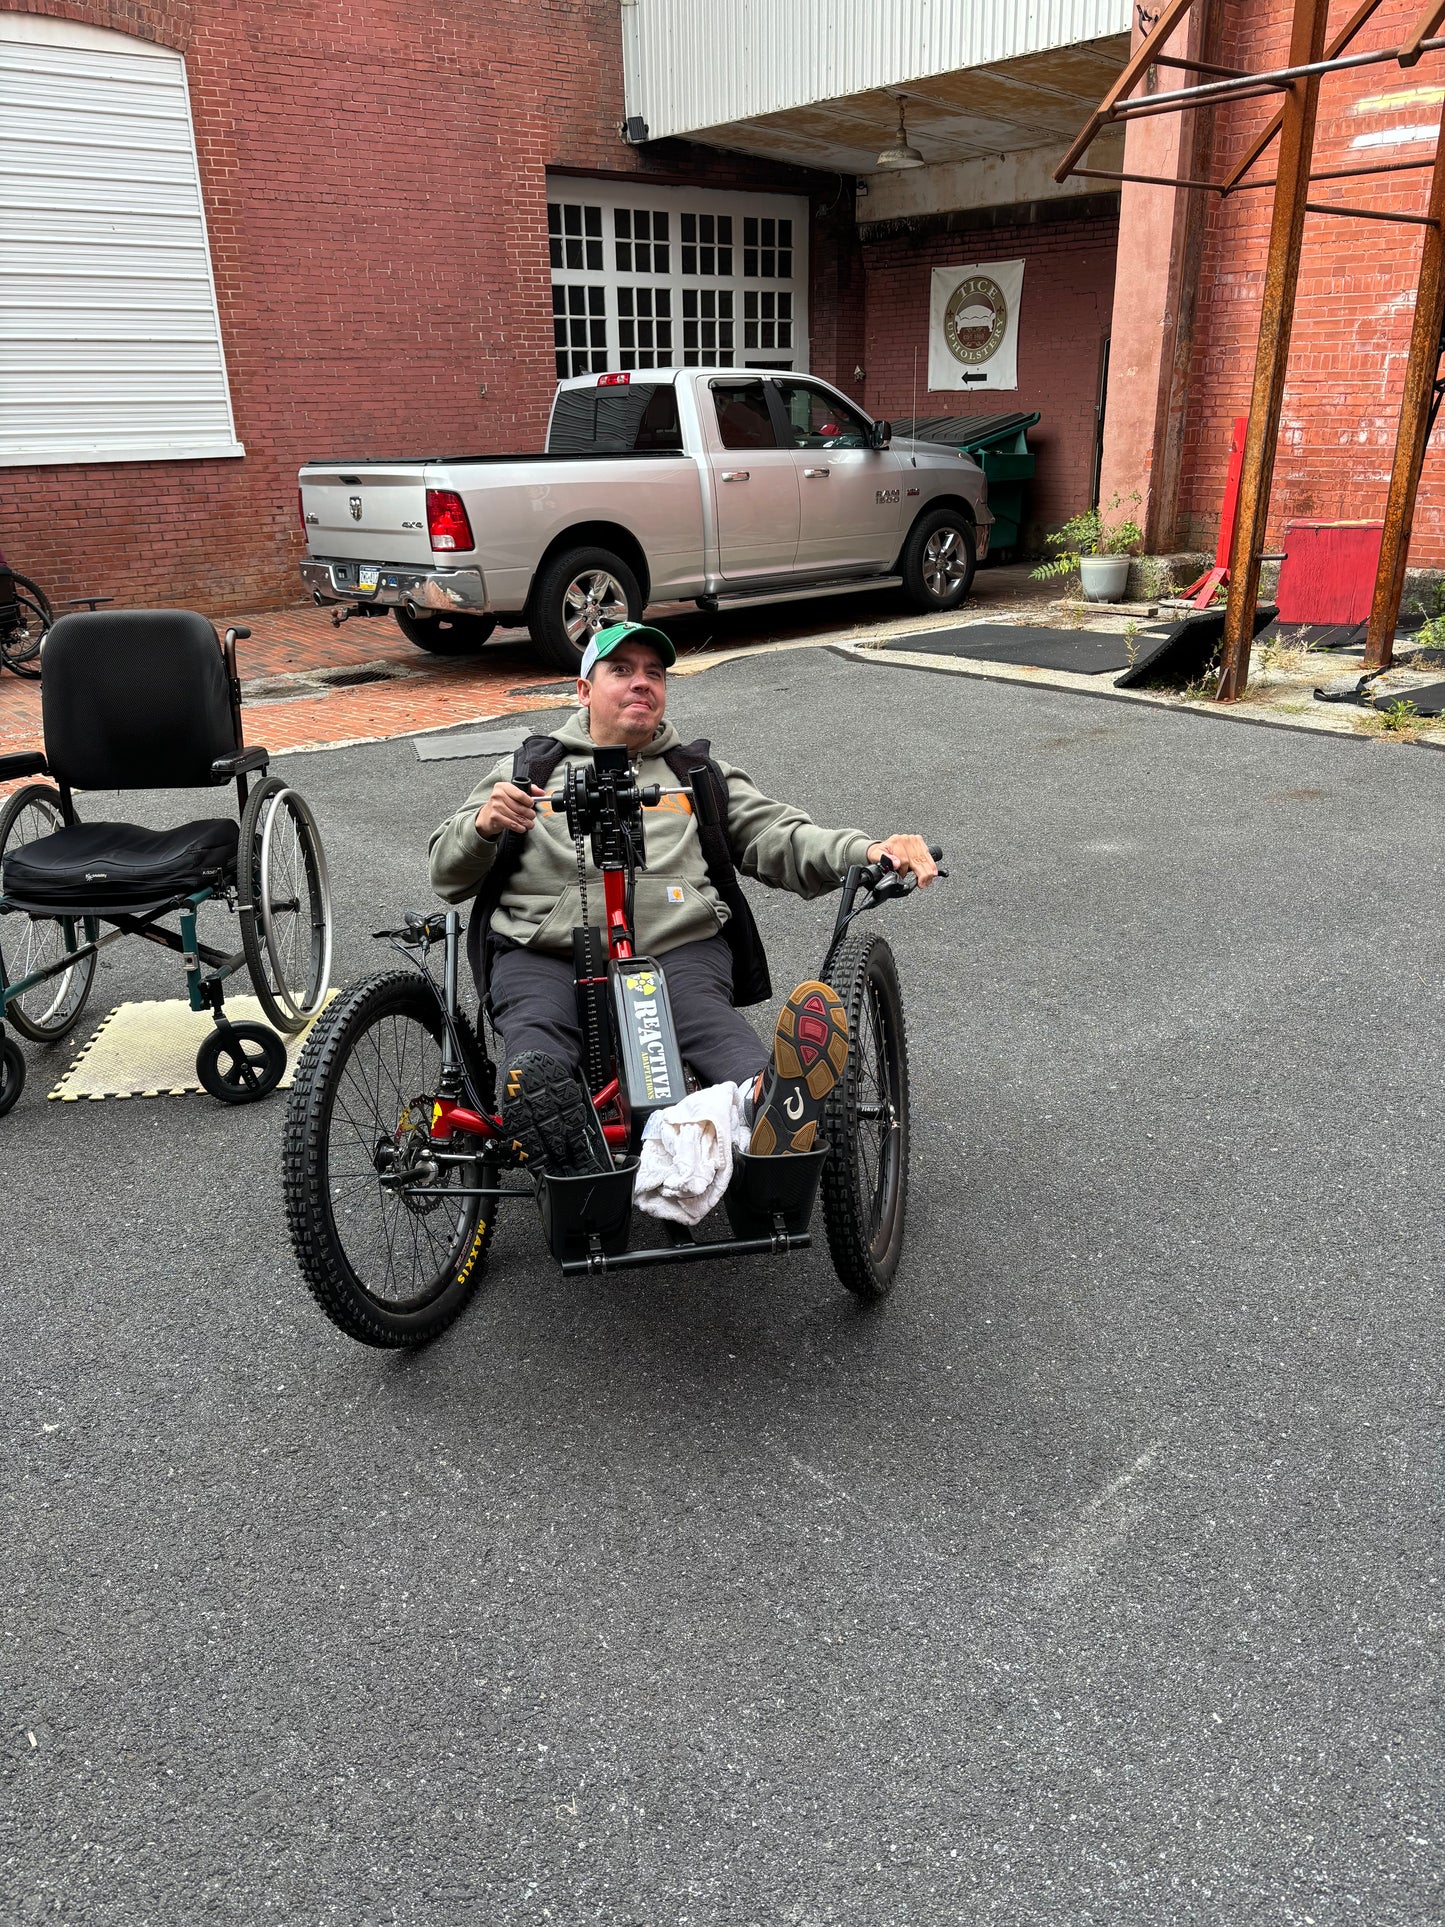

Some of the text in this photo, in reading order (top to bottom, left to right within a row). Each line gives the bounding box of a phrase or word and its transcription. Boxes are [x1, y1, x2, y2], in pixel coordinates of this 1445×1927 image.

[957, 280, 998, 300] TICE
[946, 318, 1004, 360] UPHOLSTERY
[633, 999, 672, 1099] REACTIVE
[641, 1052, 655, 1100] ADAPTATIONS
[457, 1219, 486, 1284] MAXXIS
